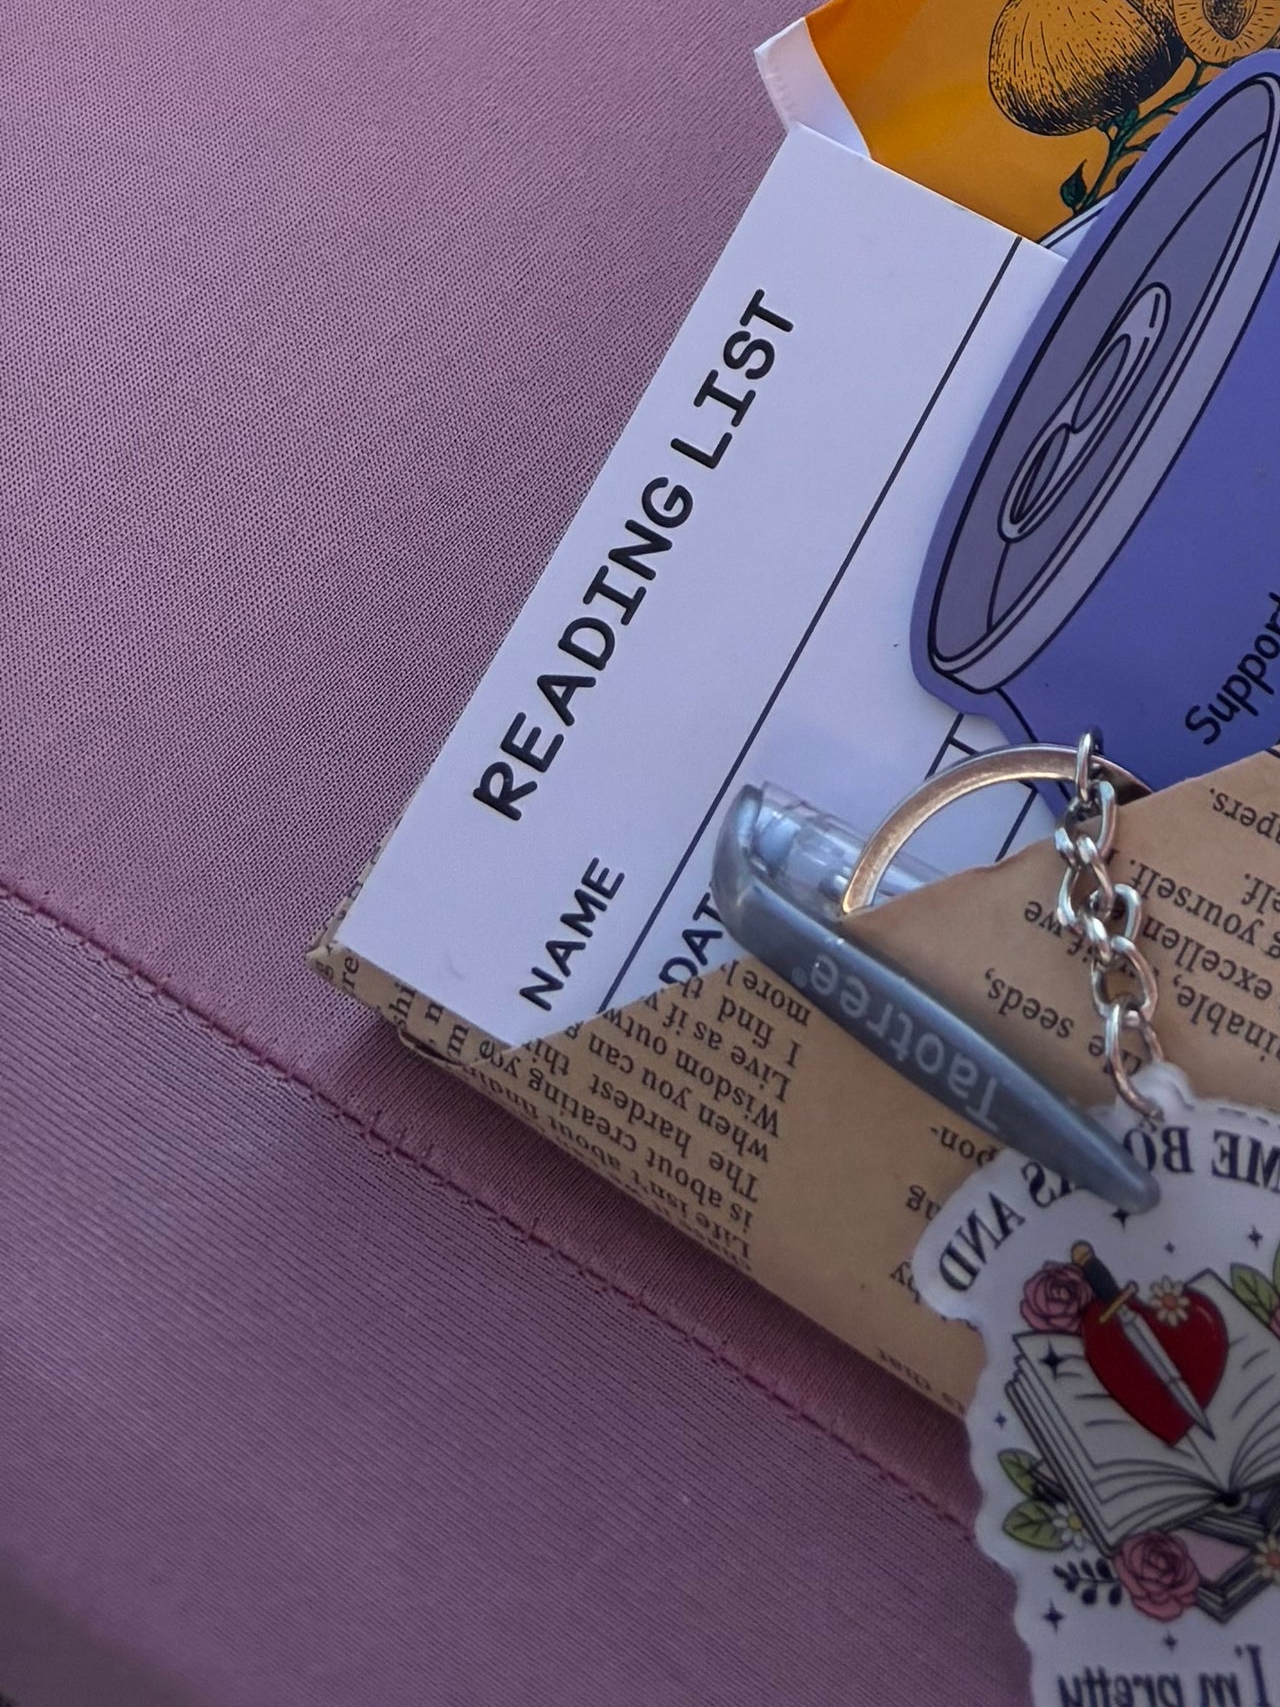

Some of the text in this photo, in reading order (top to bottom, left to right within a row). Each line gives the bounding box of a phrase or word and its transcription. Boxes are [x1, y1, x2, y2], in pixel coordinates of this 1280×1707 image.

[472, 288, 797, 821] READING LIST
[518, 854, 628, 1013] NAME
[658, 894, 734, 990] DAT
[981, 966, 1073, 1044] seeds,
